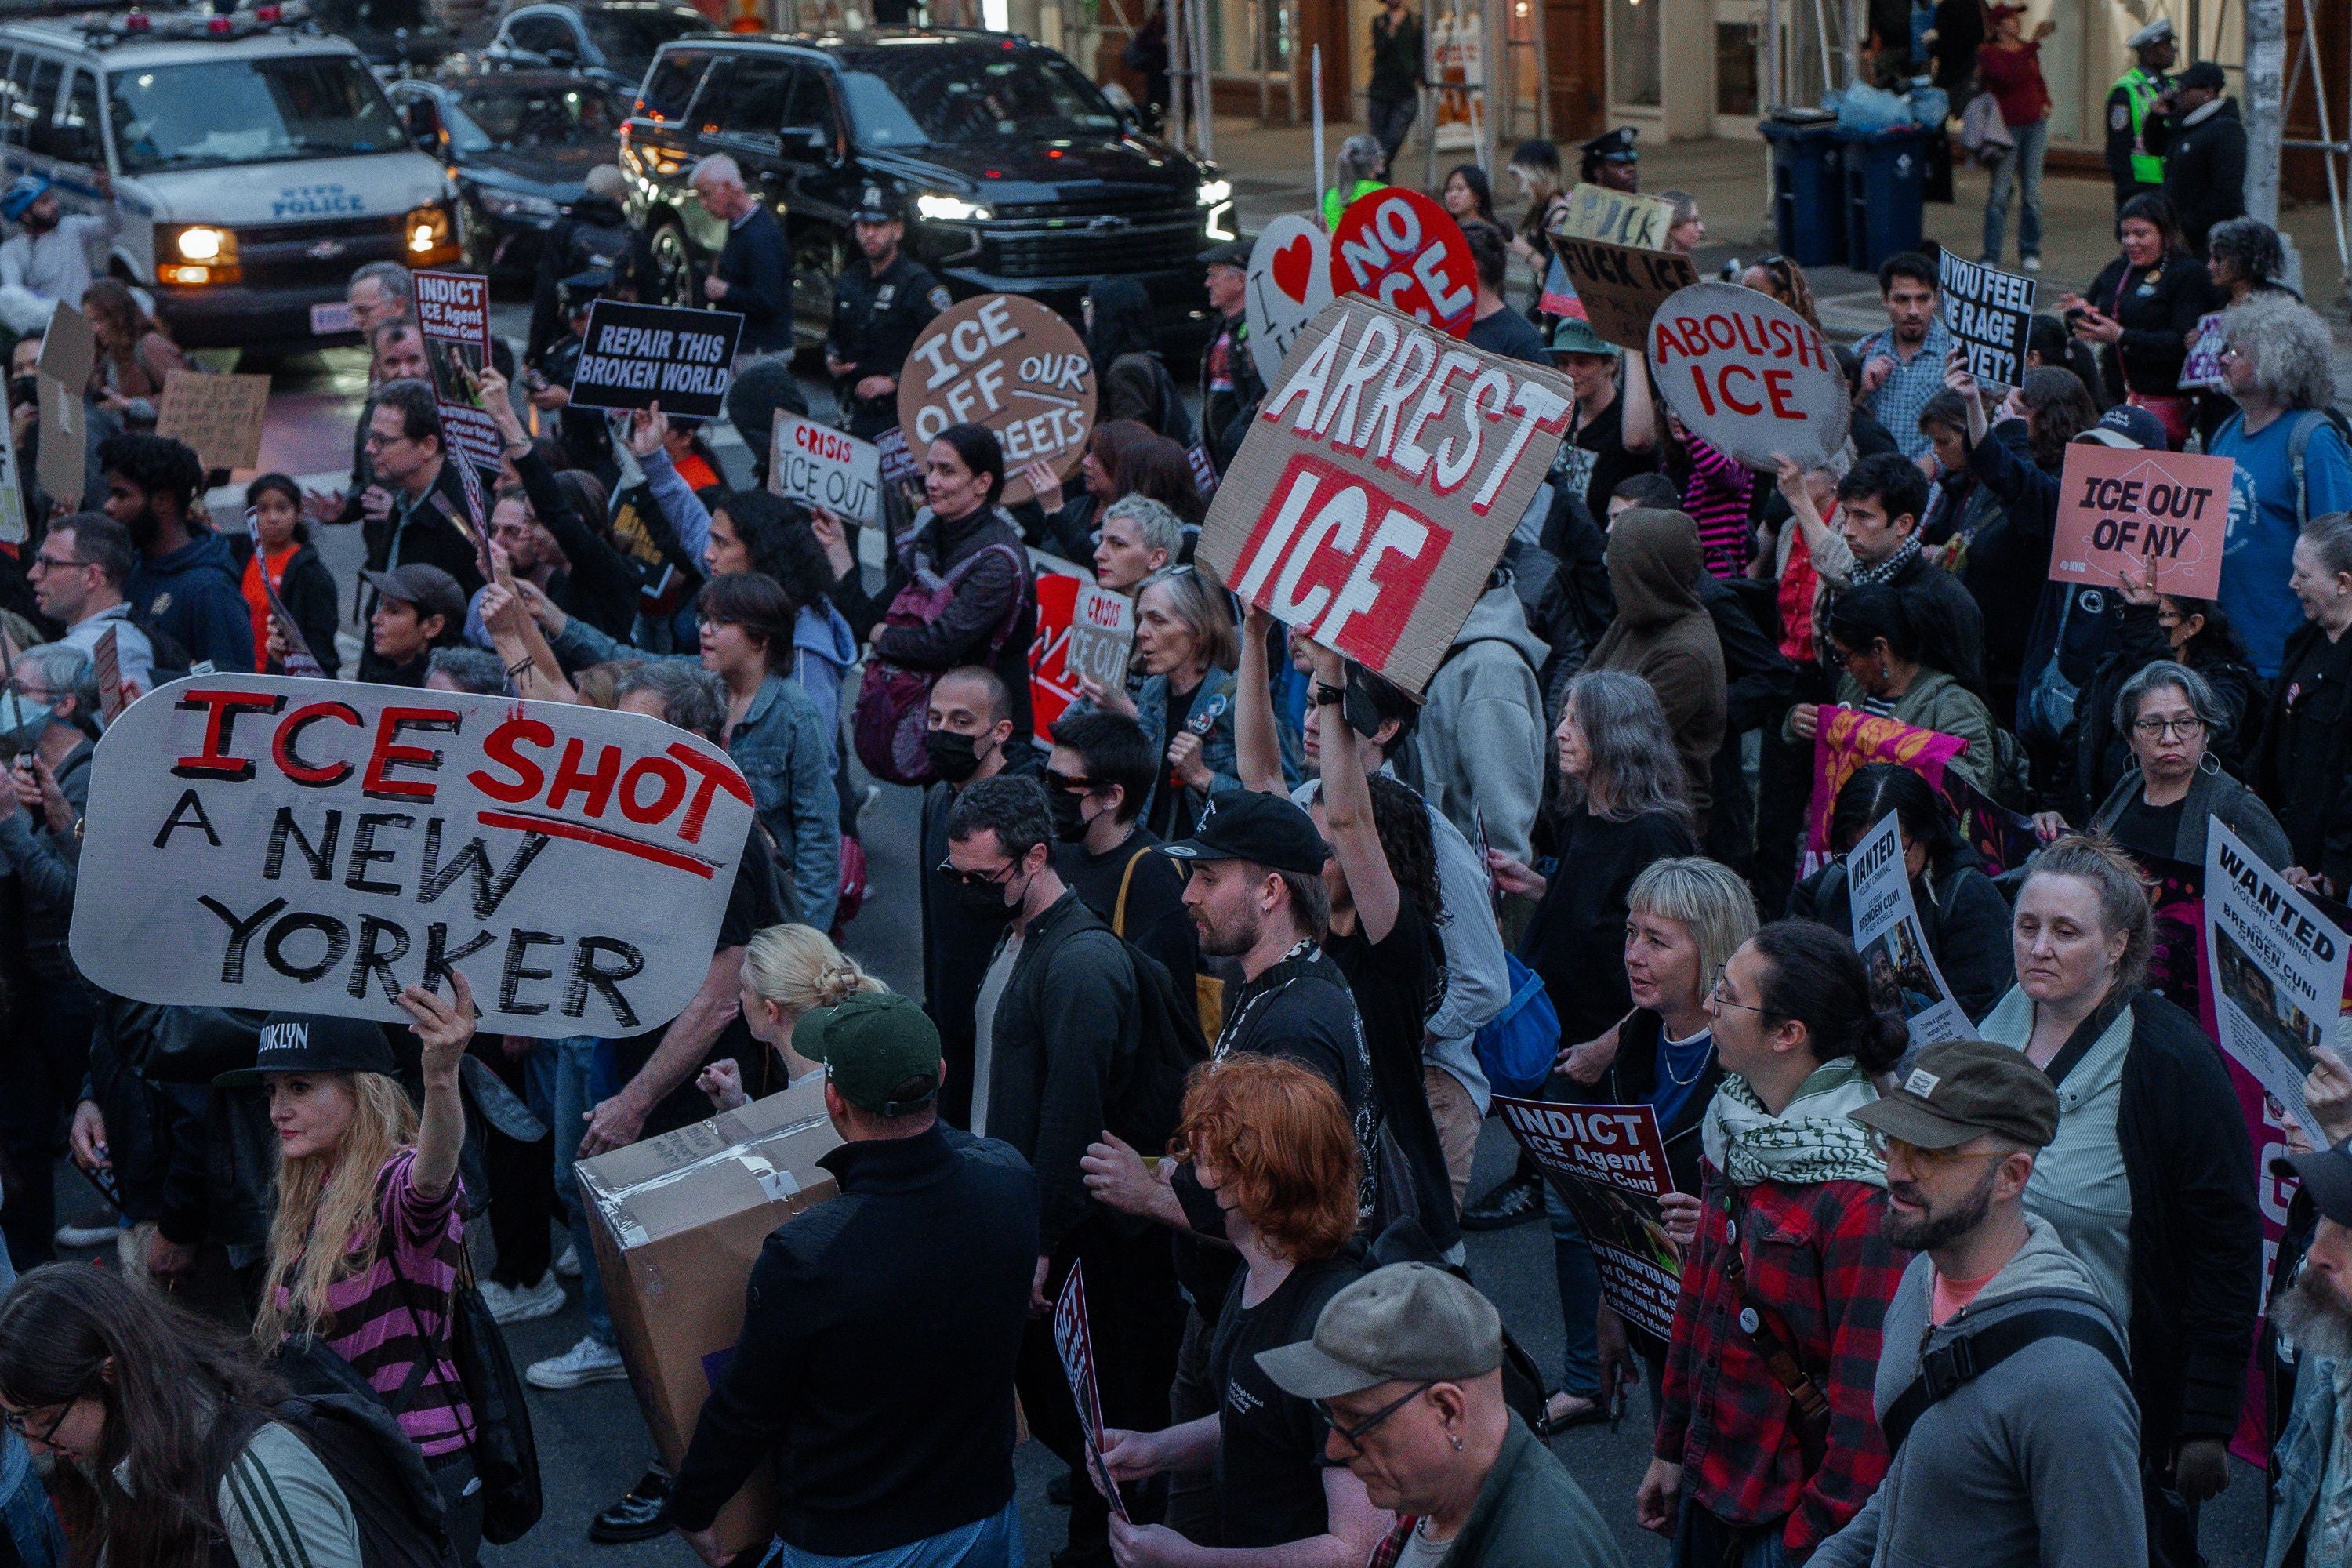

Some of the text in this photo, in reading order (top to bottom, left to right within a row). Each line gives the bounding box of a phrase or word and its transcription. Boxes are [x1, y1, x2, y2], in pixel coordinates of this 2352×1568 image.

[273, 195, 364, 216] POLICE
[1341, 198, 1422, 290] NO
[1555, 240, 1690, 291] FUCK ICE
[418, 277, 483, 306] INDICT
[1251, 270, 1276, 335] I
[1379, 240, 1475, 326] CE
[1950, 257, 1982, 301] YOU
[1981, 270, 2031, 314] FEEL
[421, 302, 483, 327] ICE Agent
[1961, 301, 2017, 349] RAGE
[597, 325, 726, 364] REPAIR THIS
[913, 296, 1022, 390] ICE
[1656, 312, 1828, 372] ABOLISH
[1965, 339, 2017, 384] YET?
[578, 354, 729, 395] BROKEN WORLD
[1018, 353, 1088, 394] OUR
[1690, 365, 1808, 420] ICE
[916, 358, 1005, 445] OFF
[1262, 310, 1573, 517] ARREST
[795, 425, 852, 463] CRISIS
[782, 449, 876, 516] ICE OUT
[2078, 477, 2143, 513] ICE
[2147, 484, 2213, 520] OUT
[2092, 519, 2140, 551] OF
[2141, 524, 2191, 558] NY
[1236, 470, 1431, 659] ICE
[1087, 596, 1121, 627] CRISIS
[1094, 637, 1129, 690] OUT
[170, 690, 755, 844] ICE SHOT
[153, 789, 551, 920] A NEW
[1852, 829, 1896, 891] WANTED
[1858, 863, 1892, 898] VIOLENT CRIMINAL
[2220, 842, 2335, 963] WANTED
[1858, 888, 1900, 933] BRENDEN CUNI
[2232, 881, 2314, 965] VIOLENT CRIMINAL
[197, 895, 644, 1028] YORKER
[2223, 902, 2317, 1002] BRENDEN CUNI
[1504, 1104, 1642, 1145] INDICT
[1522, 1133, 1654, 1171] ICE Agent
[1535, 1152, 1659, 1192] Brendan Cuni
[1588, 1240, 1606, 1258] for
[1605, 1246, 1662, 1286] ATTEMPTED
[1602, 1264, 1678, 1311] of Oscar Be
[1648, 1301, 1658, 1316] in
[1657, 1306, 1672, 1323] the
